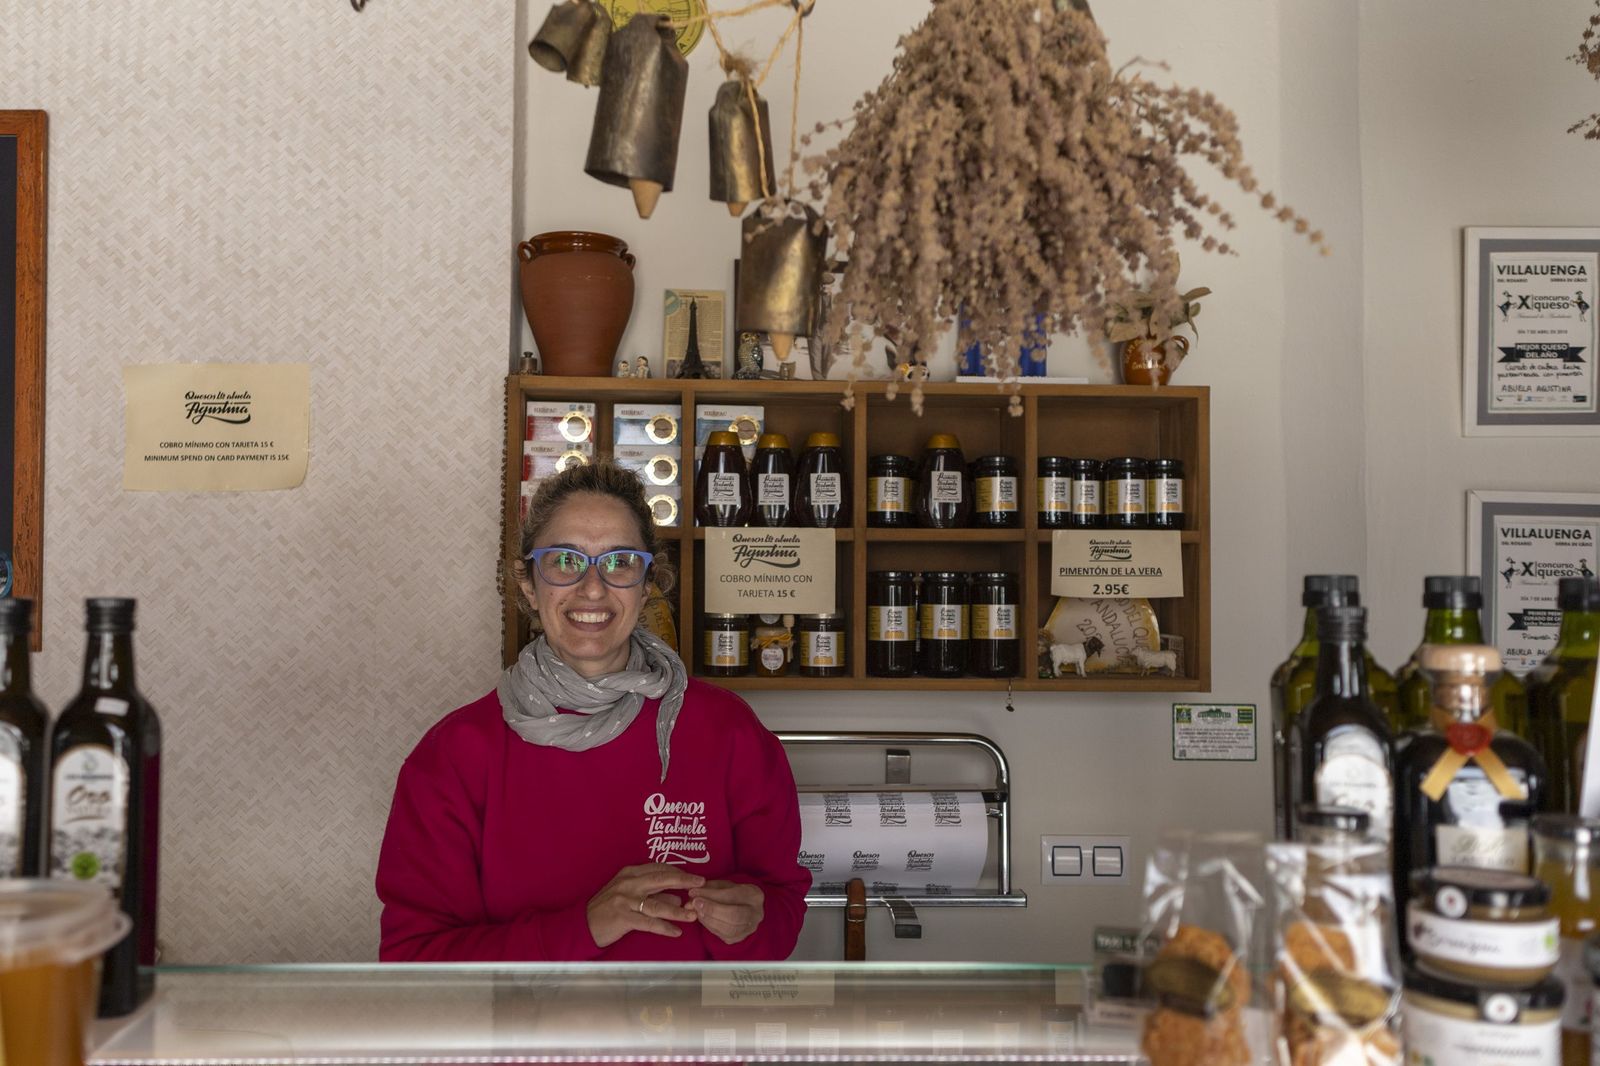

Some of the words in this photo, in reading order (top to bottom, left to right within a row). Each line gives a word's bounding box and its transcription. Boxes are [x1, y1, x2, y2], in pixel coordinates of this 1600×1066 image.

[1497, 264, 1587, 276] VILLALUENGA
[1518, 295, 1530, 310] X
[1534, 302, 1570, 312] queso
[185, 391, 215, 400] Quesos
[226, 391, 251, 400] abuela
[185, 400, 251, 425] Agustina
[185, 440, 214, 449] MÍNIMO
[732, 534, 764, 543] Quesos
[774, 534, 801, 543] abuela
[1501, 528, 1592, 540] VILLALUENGA
[732, 544, 800, 568] Agustina
[1089, 545, 1132, 560] Agustina
[1060, 566, 1108, 575] PIMENTÓN
[1521, 562, 1534, 576] X
[1538, 569, 1574, 579] queso
[720, 574, 751, 583] COBRO
[754, 573, 791, 583] MÍNIMO
[793, 574, 813, 583] CON
[738, 589, 774, 598] TARJETA
[777, 590, 788, 598] 15
[790, 590, 796, 598] €
[1093, 584, 1129, 595] 2.95€
[644, 793, 705, 815] Quesos
[648, 816, 664, 835] La
[664, 816, 706, 835] abuela
[646, 835, 710, 864] Agustina
[853, 850, 880, 858] Quesos
[907, 850, 934, 858] Quesos
